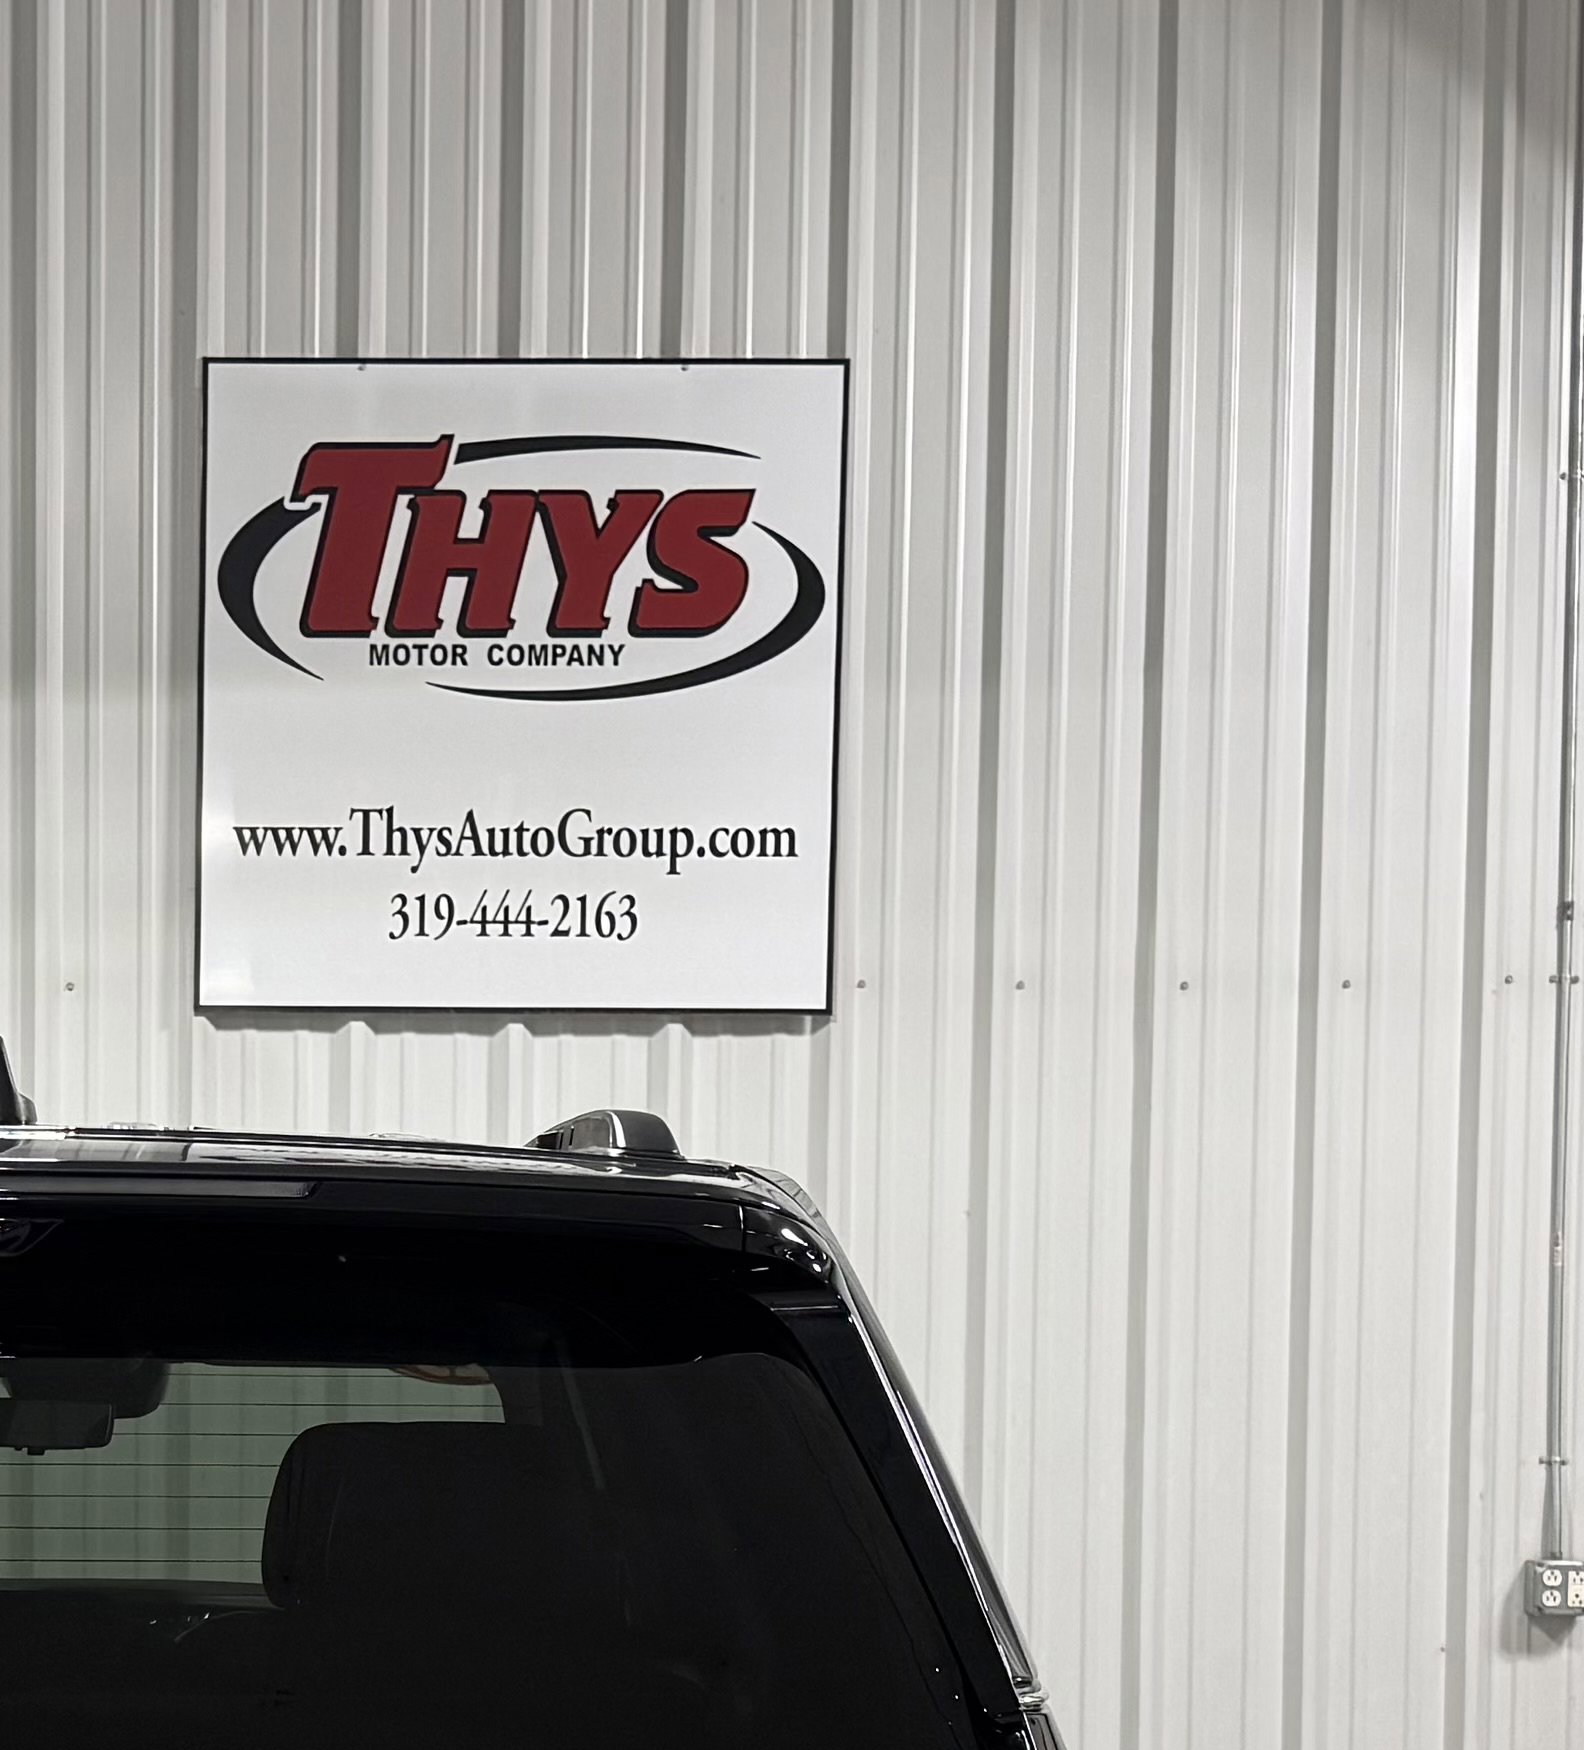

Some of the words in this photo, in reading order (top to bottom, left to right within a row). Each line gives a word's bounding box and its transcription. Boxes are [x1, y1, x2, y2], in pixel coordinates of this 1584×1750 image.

[289, 434, 756, 638] THYS
[369, 644, 468, 667] MOTOR
[487, 643, 626, 667] COMPANY
[233, 806, 799, 875] www.ThysAutoGroup.com
[388, 888, 639, 941] 319-444-2163
